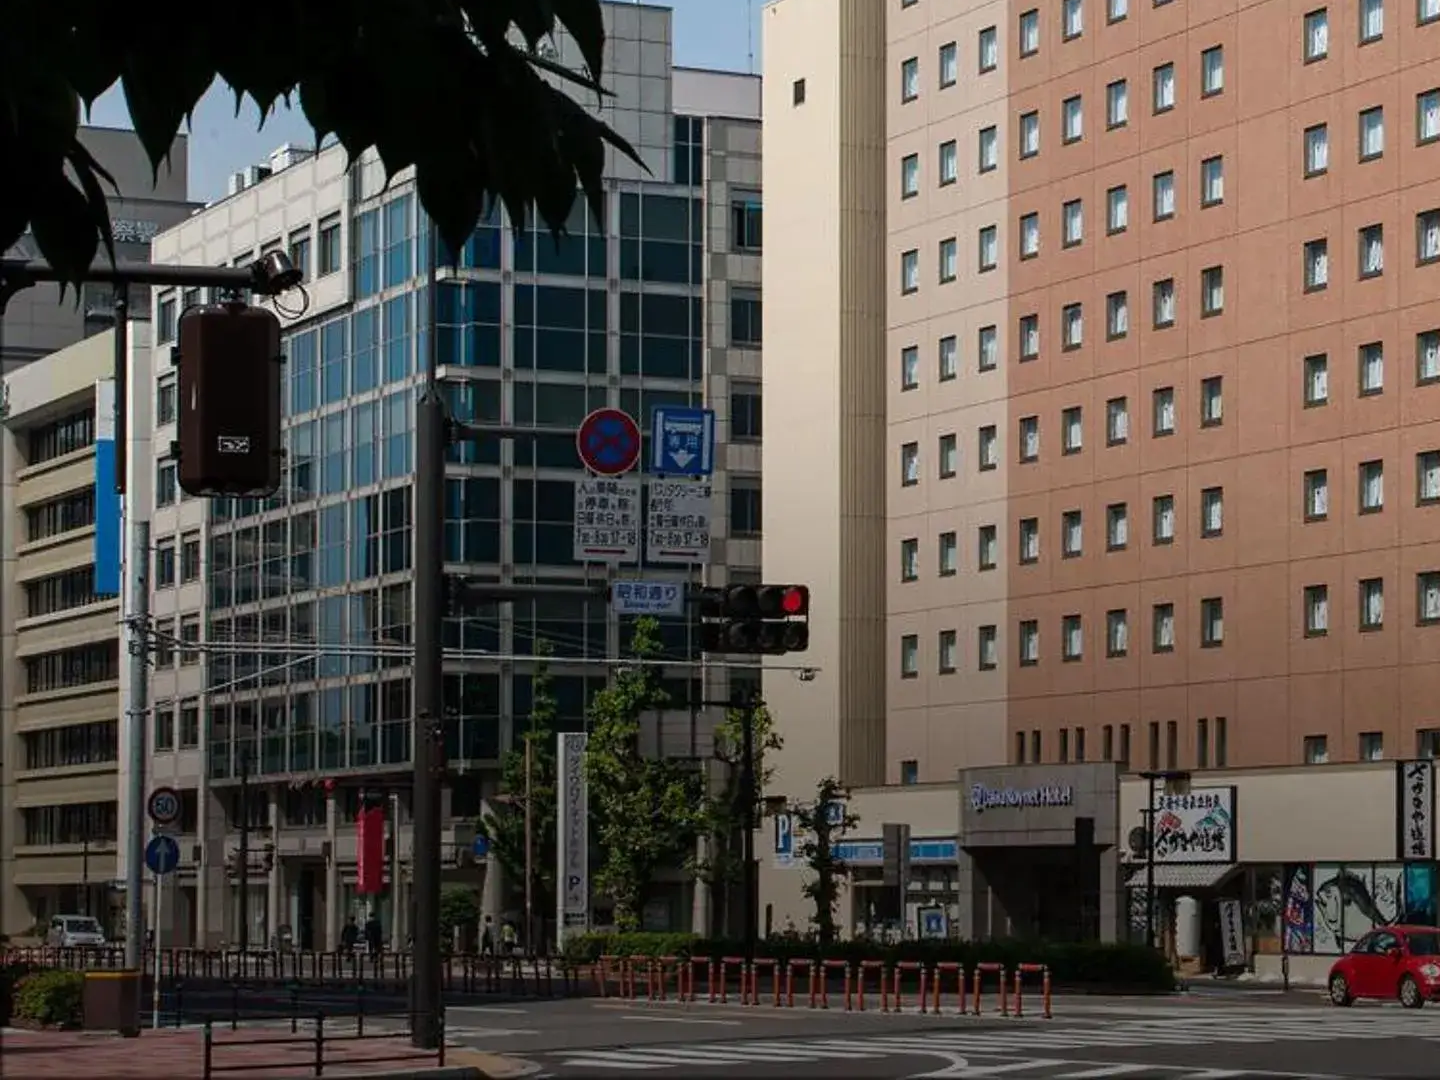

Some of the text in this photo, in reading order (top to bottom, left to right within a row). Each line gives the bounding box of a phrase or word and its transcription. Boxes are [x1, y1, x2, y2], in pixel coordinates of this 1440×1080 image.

[617, 584, 677, 601] 昭和通り
[1040, 785, 1072, 806] Hotel
[155, 796, 175, 815] 50
[778, 814, 789, 849] P
[569, 874, 581, 890] P
